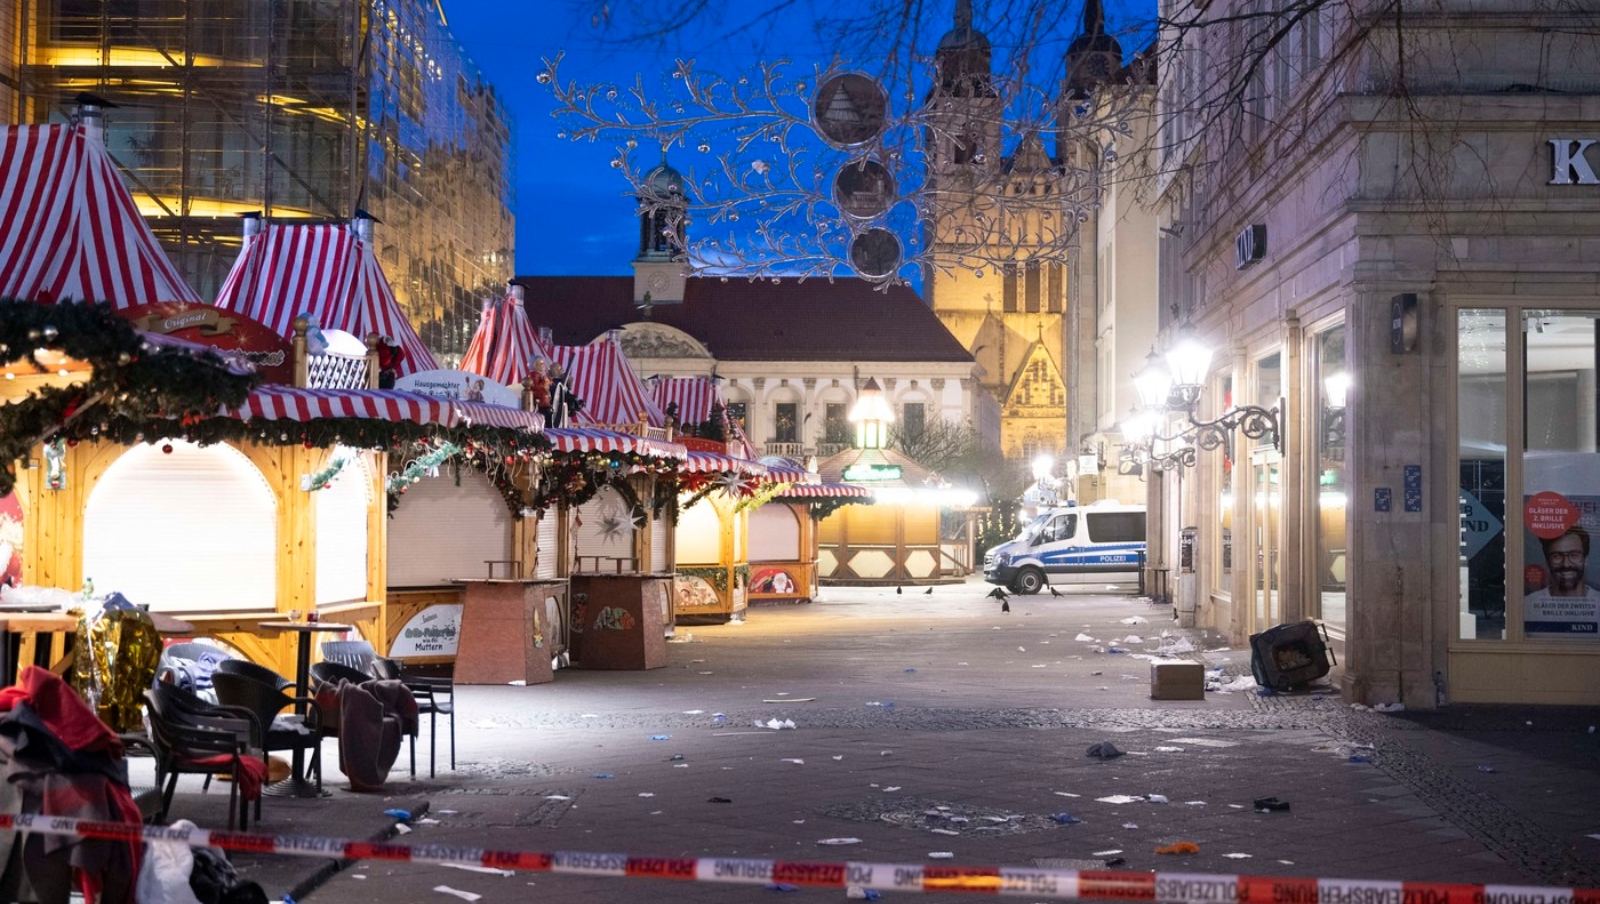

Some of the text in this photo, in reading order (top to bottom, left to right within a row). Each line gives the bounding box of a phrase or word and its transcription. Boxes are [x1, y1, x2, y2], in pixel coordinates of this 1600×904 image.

[164, 312, 206, 330] Original
[414, 380, 460, 391] Hausgemachter
[1528, 506, 1569, 515] GLÄSER DER
[1100, 555, 1127, 563] POLIZEI
[1533, 602, 1556, 610] GLÄSER
[1571, 624, 1593, 632] KIND
[415, 642, 443, 651] Muttern
